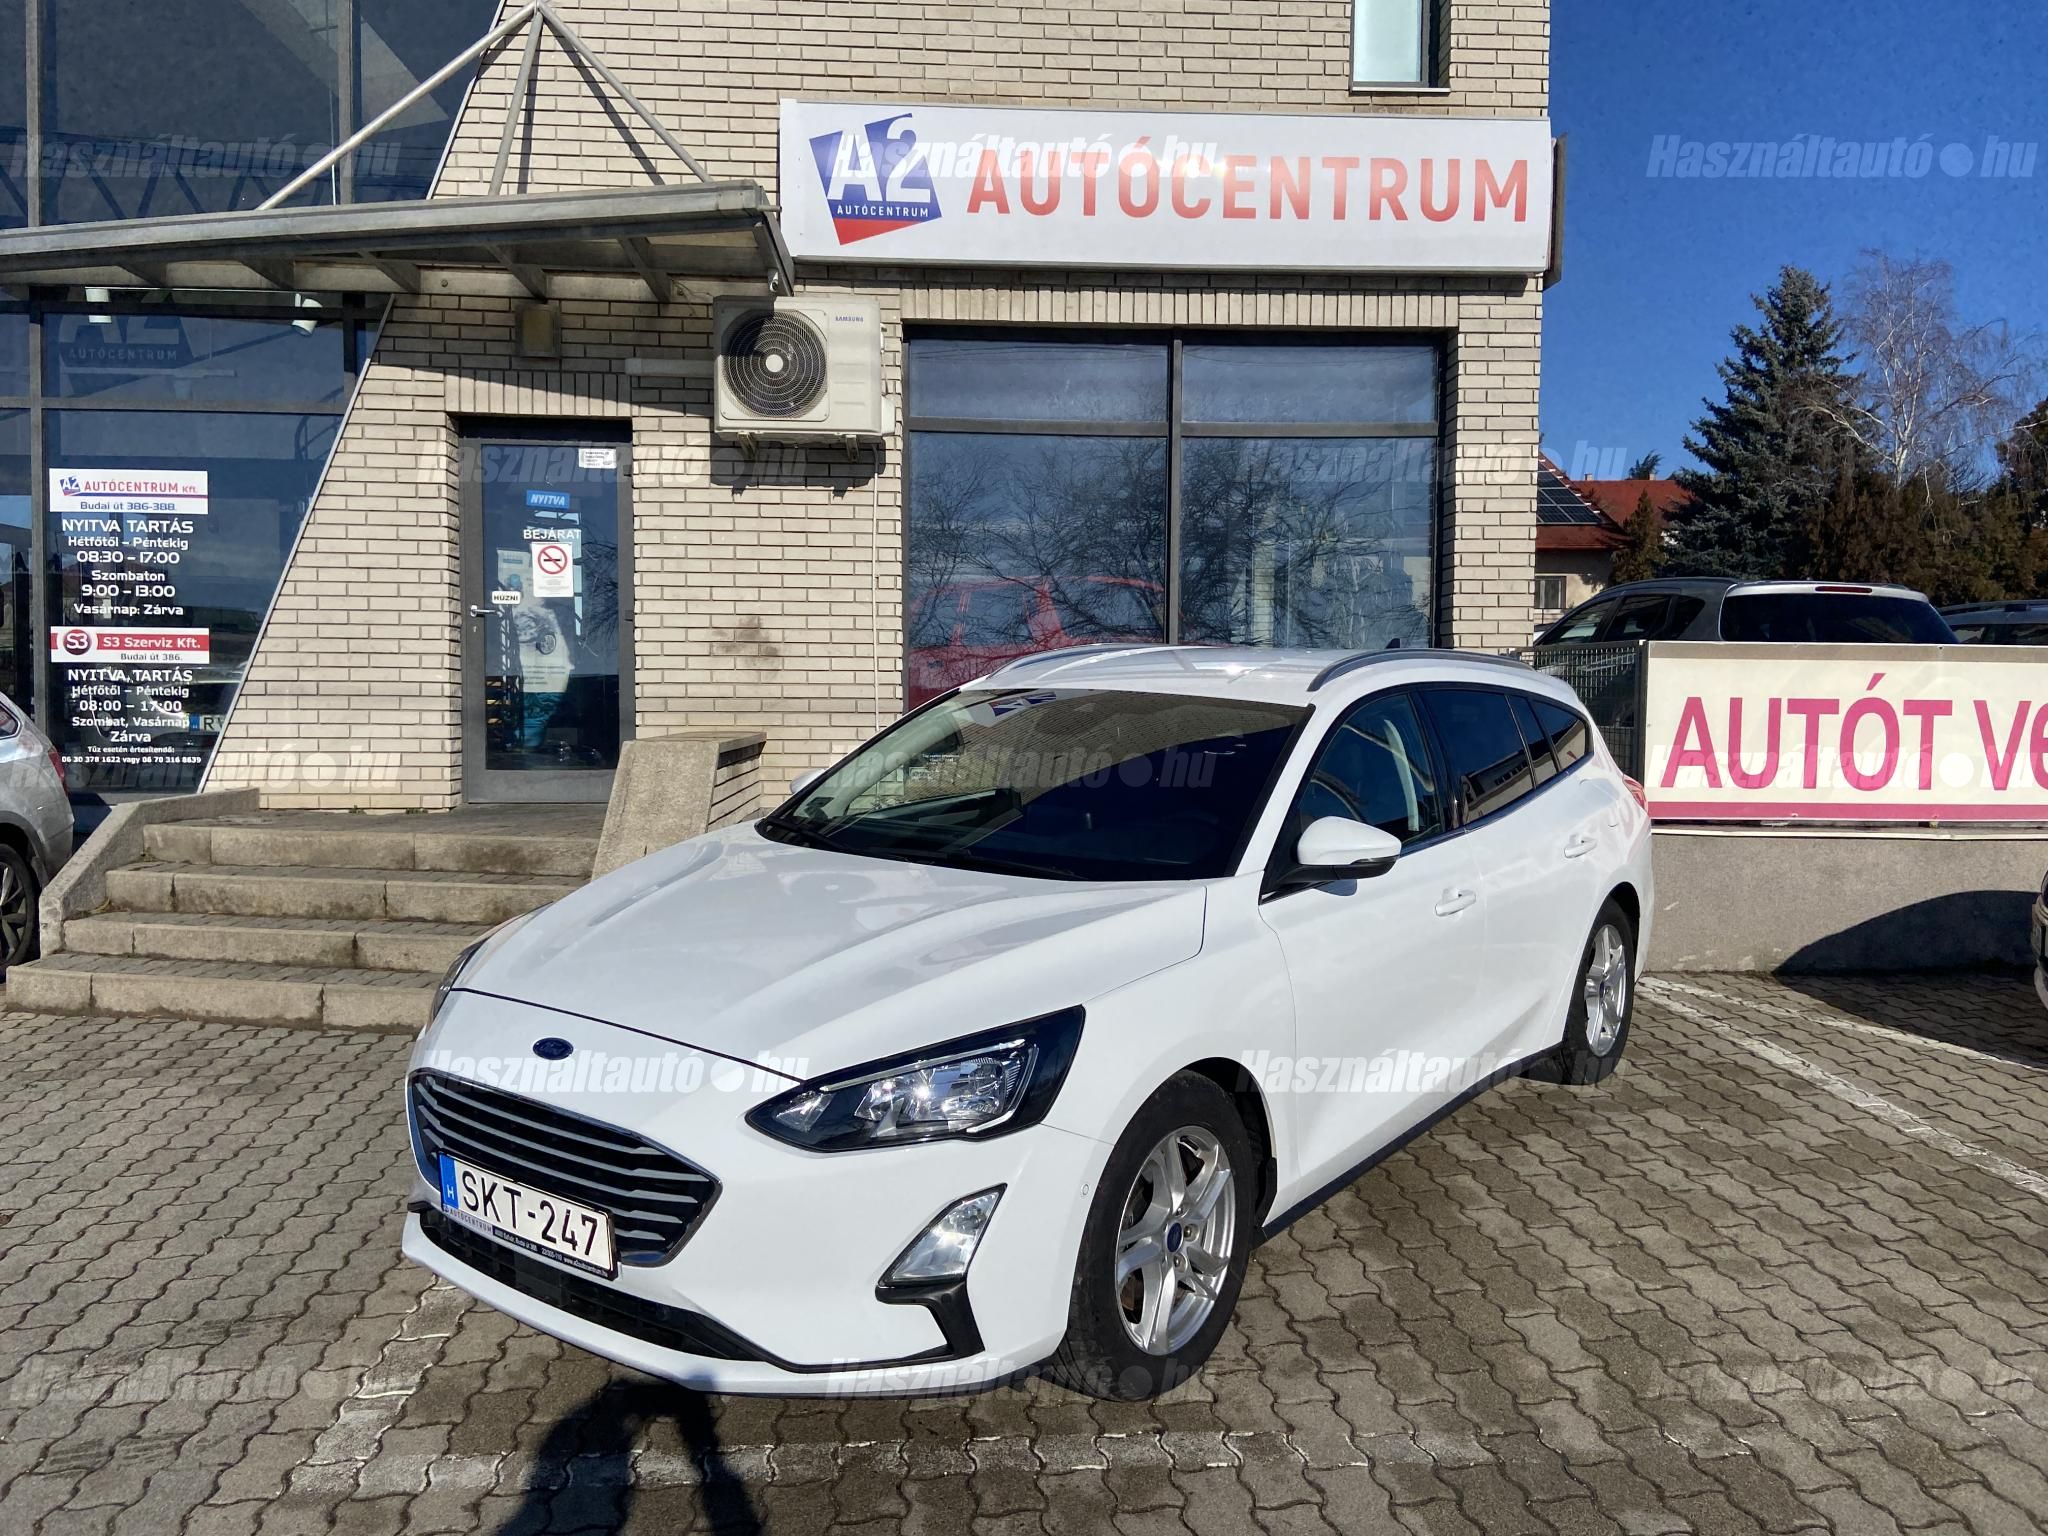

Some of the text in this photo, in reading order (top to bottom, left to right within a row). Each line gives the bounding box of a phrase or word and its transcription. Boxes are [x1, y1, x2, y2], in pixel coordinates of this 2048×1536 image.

[825, 112, 931, 203] A2
[966, 137, 1527, 223] AUTÓCENTRUM
[837, 204, 929, 217] AUTÓCENTRUM
[84, 479, 178, 493] AUTÓCENTRUM
[80, 501, 110, 510] Budai
[113, 502, 123, 510] út
[530, 494, 566, 506] NYITVA
[62, 518, 194, 533] NYITVA TARTÁS
[523, 527, 582, 540] BEJÁRAT
[68, 536, 119, 547] Hétfőtől
[133, 537, 189, 550] Péntekig
[76, 551, 123, 563] 08:30
[140, 552, 180, 564] 17:00
[92, 570, 165, 581] Szombaton
[82, 585, 119, 597] 9:00
[135, 585, 176, 597] 13:00
[74, 603, 184, 616] Vasárnap: Zárva
[67, 632, 88, 649] S3
[103, 637, 201, 648] S3 Szerviz Kft.
[120, 653, 147, 661] Budai
[150, 653, 159, 661] út
[68, 666, 193, 682] NYITVA TARTÁS
[72, 685, 121, 695] Hétfőtől
[136, 685, 189, 698] Péntekig
[79, 701, 121, 711] 08:00
[141, 701, 182, 712] 17:00
[72, 716, 189, 729] Szombat, Vasárnap
[110, 730, 152, 742] Zárva
[1660, 673, 1953, 791] AUTÓT
[447, 1188, 455, 1201] H
[462, 1171, 598, 1256] SKT-247
